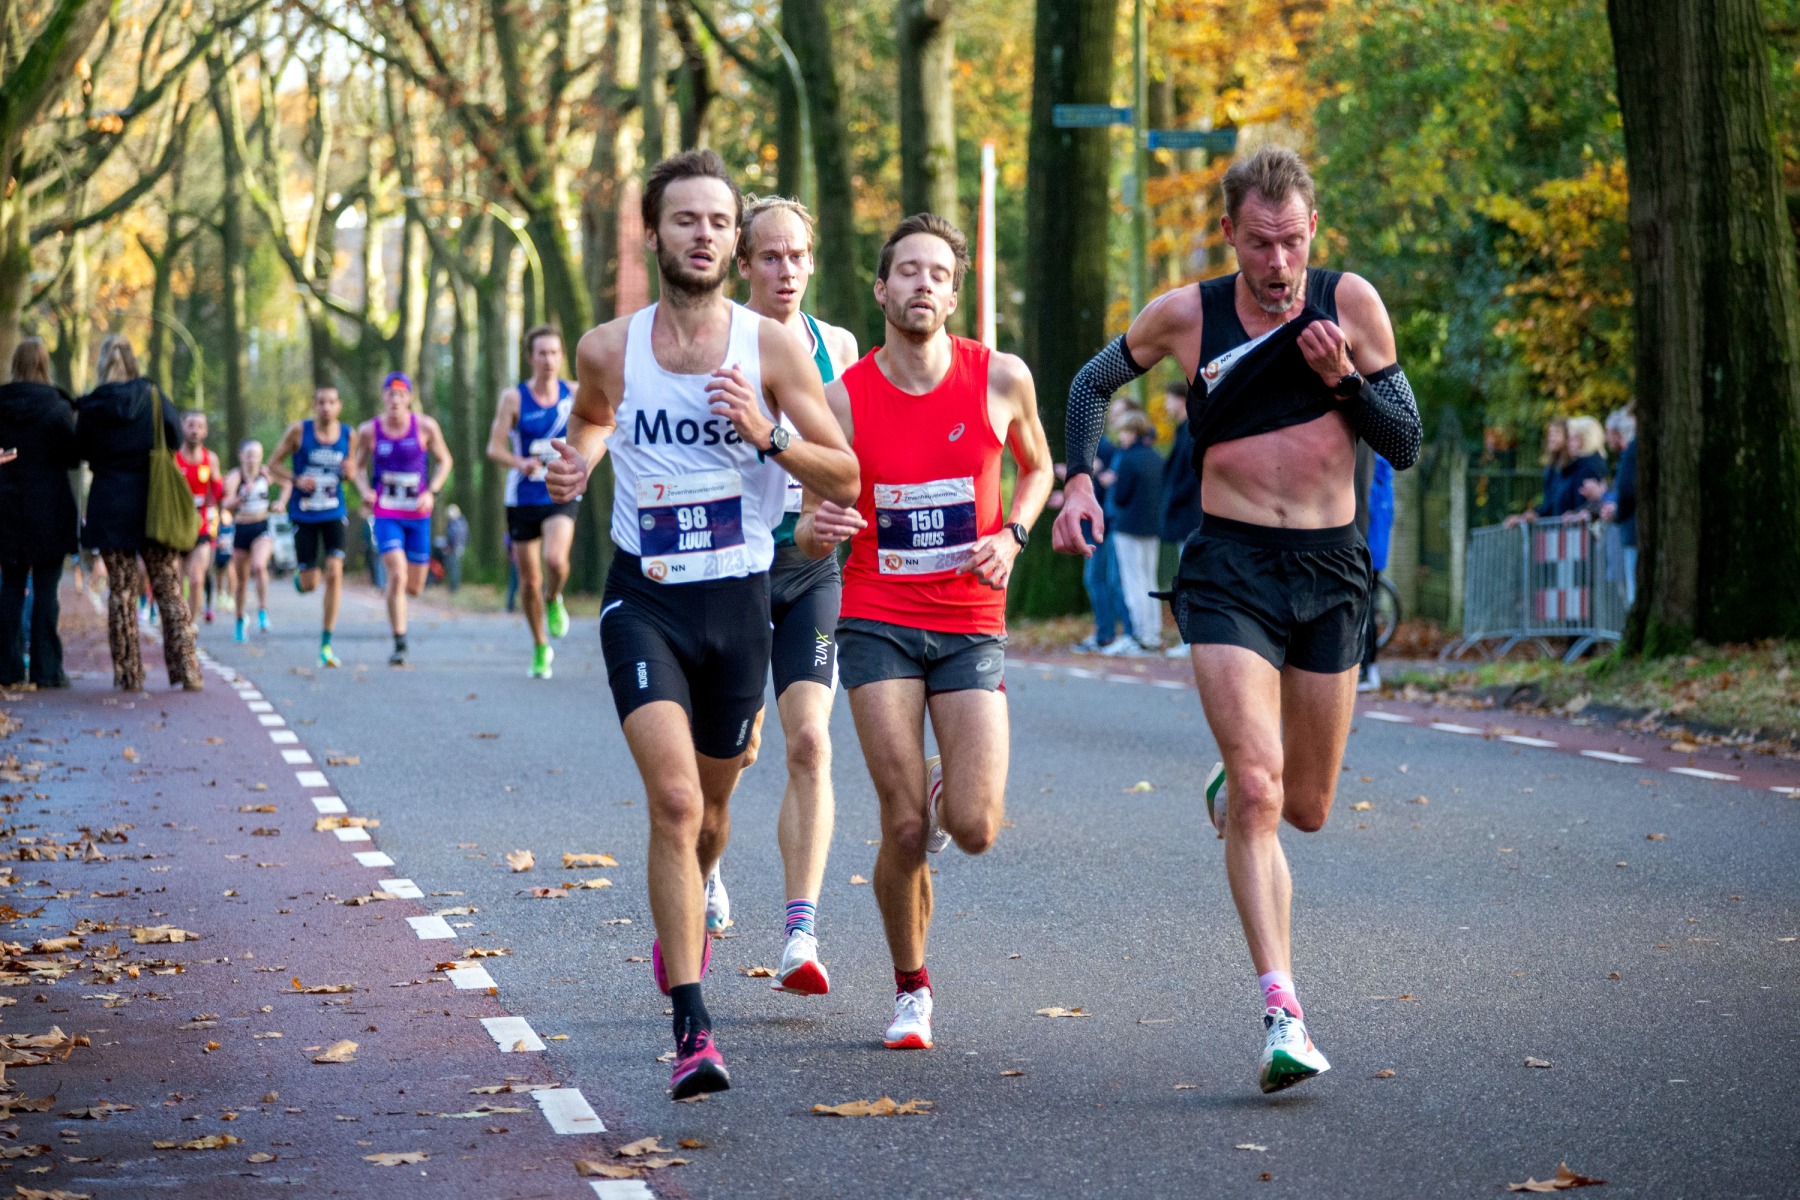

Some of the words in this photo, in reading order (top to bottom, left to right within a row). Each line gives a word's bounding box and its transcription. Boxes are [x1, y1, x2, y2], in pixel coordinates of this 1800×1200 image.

[635, 409, 743, 445] Mosa
[678, 506, 708, 531] 98
[908, 509, 944, 532] 150
[680, 531, 711, 549] LUUK
[913, 532, 944, 547] GUUS
[704, 549, 744, 576] 2023
[637, 661, 648, 689] FUSION
